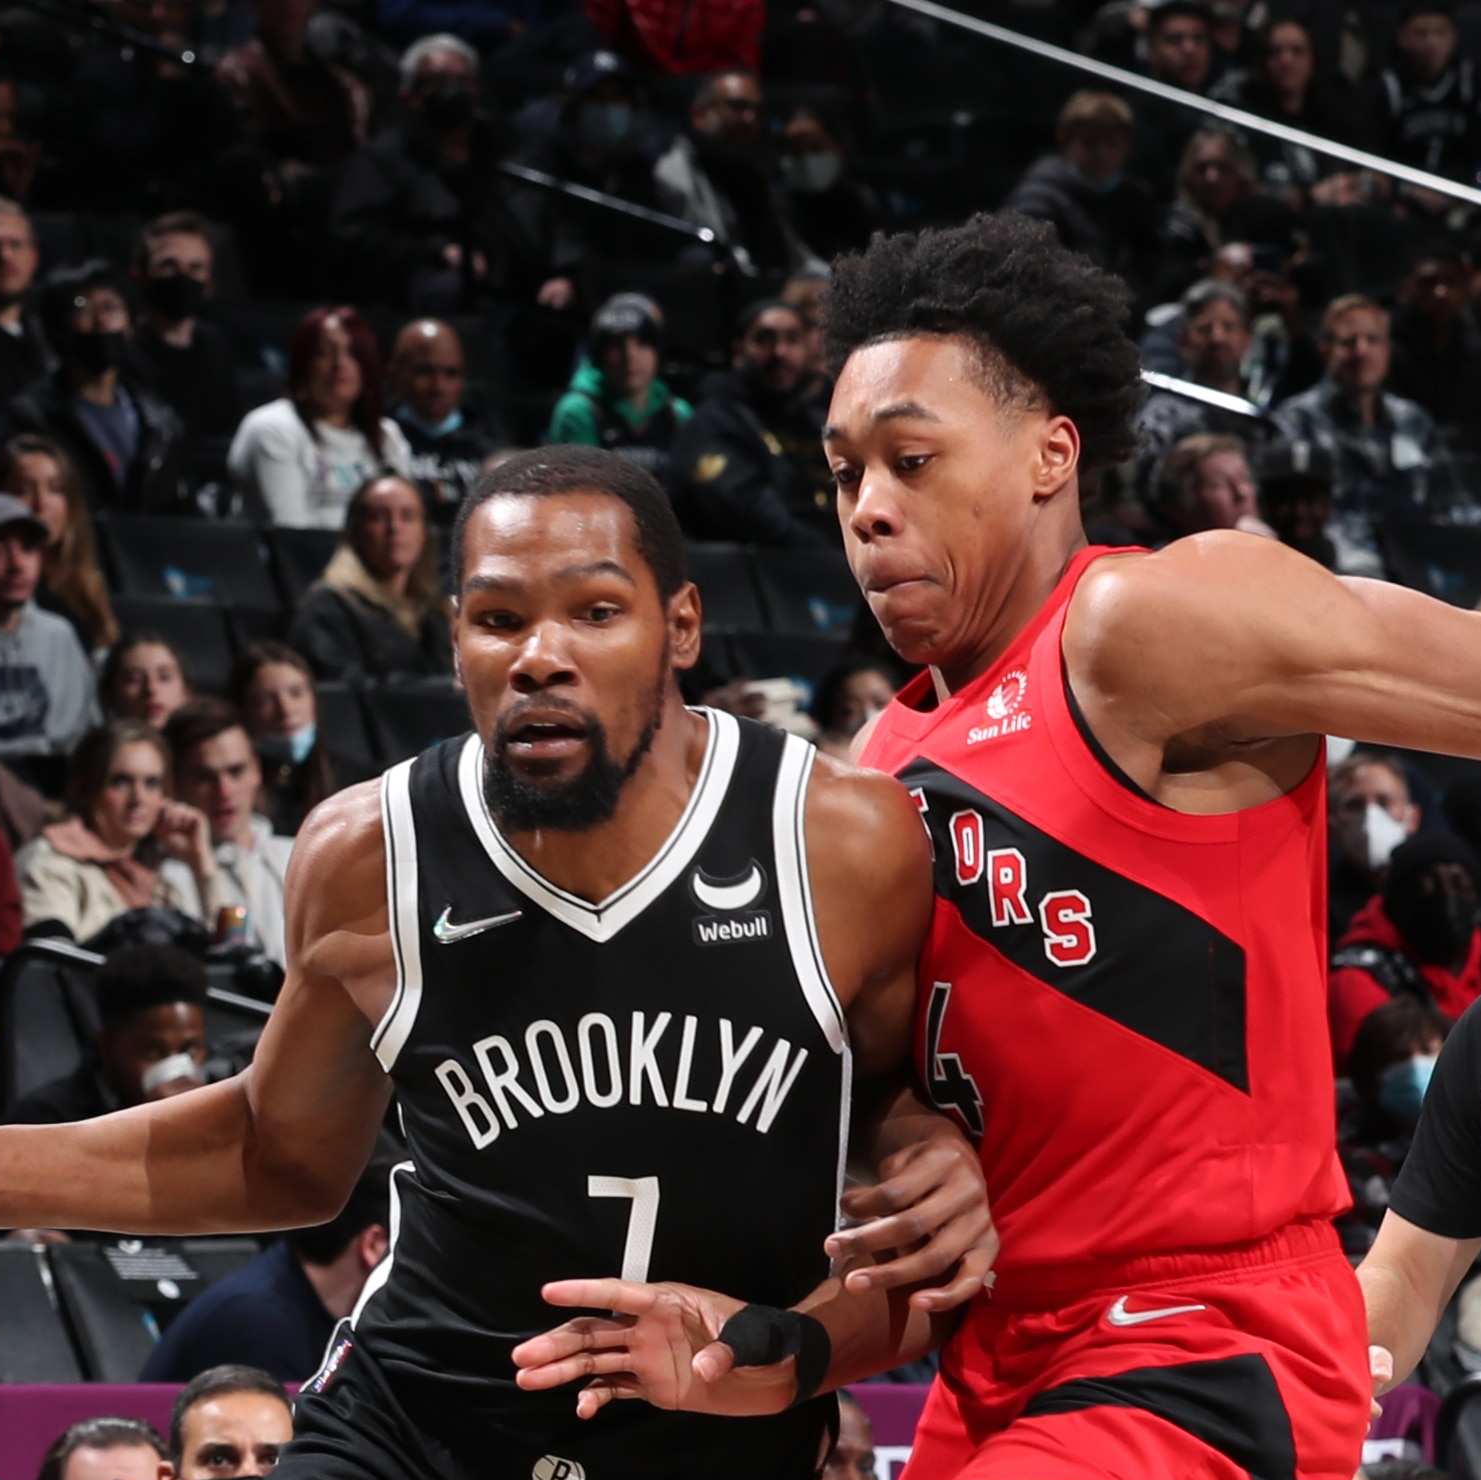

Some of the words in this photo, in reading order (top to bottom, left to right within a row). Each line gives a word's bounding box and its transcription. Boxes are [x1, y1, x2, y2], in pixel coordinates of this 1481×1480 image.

[966, 725, 999, 746] Sun
[1001, 711, 1032, 735] Life
[698, 916, 769, 942] Webull
[433, 1010, 809, 1151] BROOKLYN
[586, 1175, 660, 1285] 7
